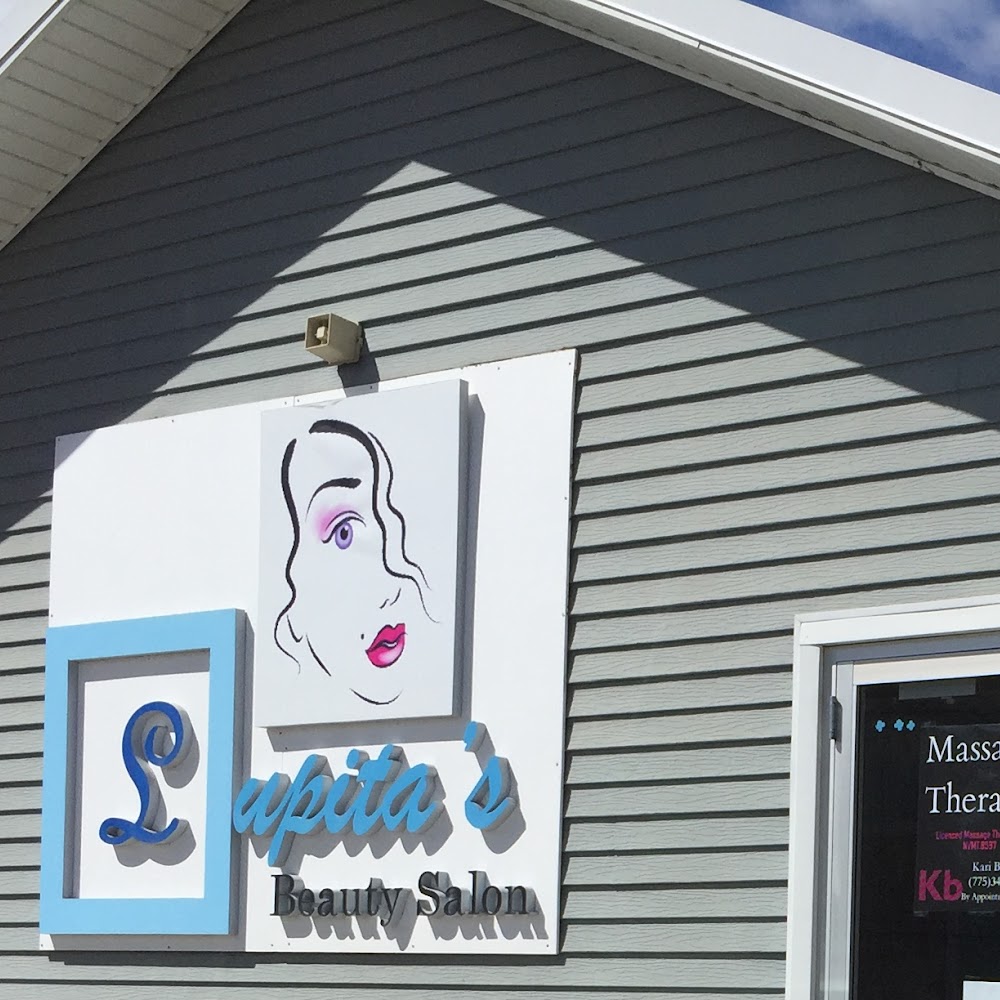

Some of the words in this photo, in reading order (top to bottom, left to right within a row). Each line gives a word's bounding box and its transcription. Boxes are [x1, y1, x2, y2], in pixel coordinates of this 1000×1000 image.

[972, 861, 991, 872] Kari
[918, 869, 964, 902] Kb
[270, 874, 403, 927] Beauty
[416, 870, 531, 916] Salon
[961, 893, 970, 902] By
